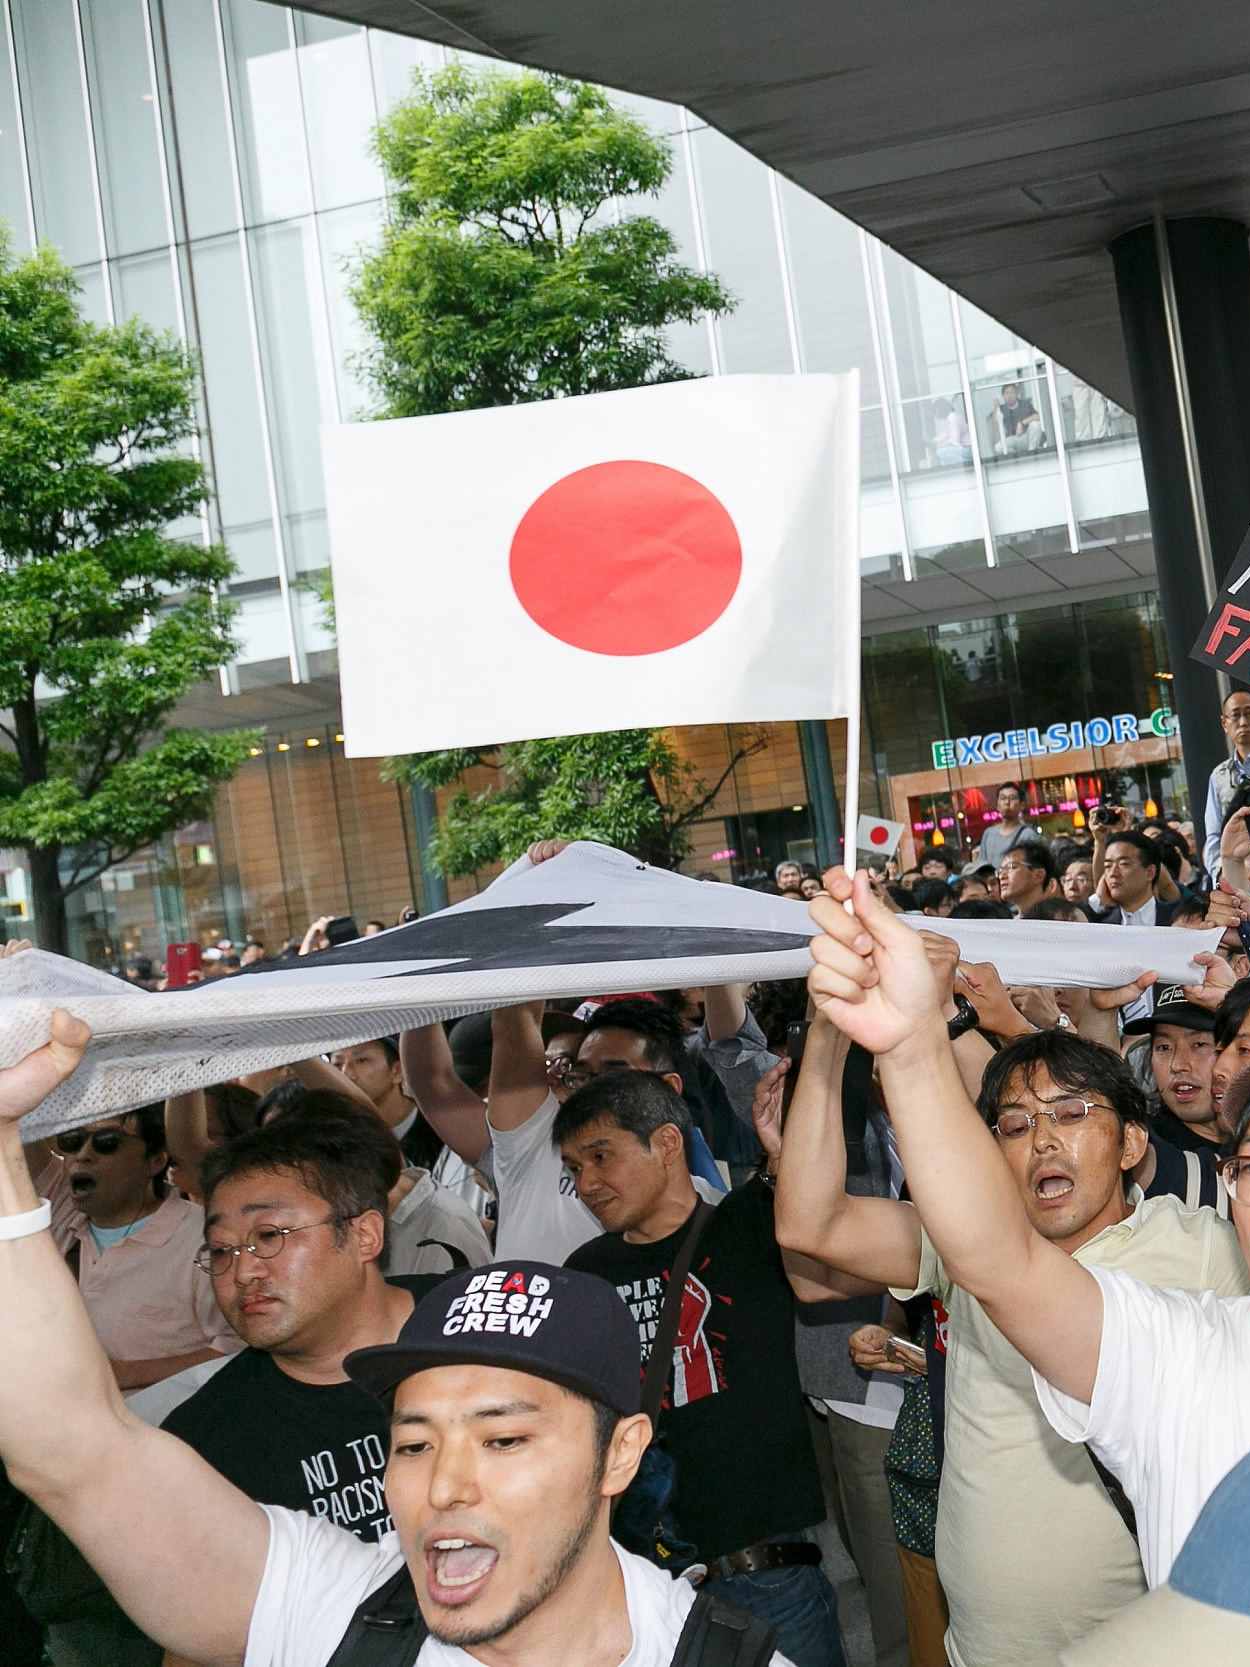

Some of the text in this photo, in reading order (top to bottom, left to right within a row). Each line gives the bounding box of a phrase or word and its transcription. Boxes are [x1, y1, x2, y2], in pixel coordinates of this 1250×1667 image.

[931, 713, 1139, 770] EXCELSIOR
[465, 1270, 550, 1296] DEAD
[445, 1292, 554, 1320] FRESH
[442, 1312, 542, 1337] CREW
[300, 1434, 386, 1495] NO TO
